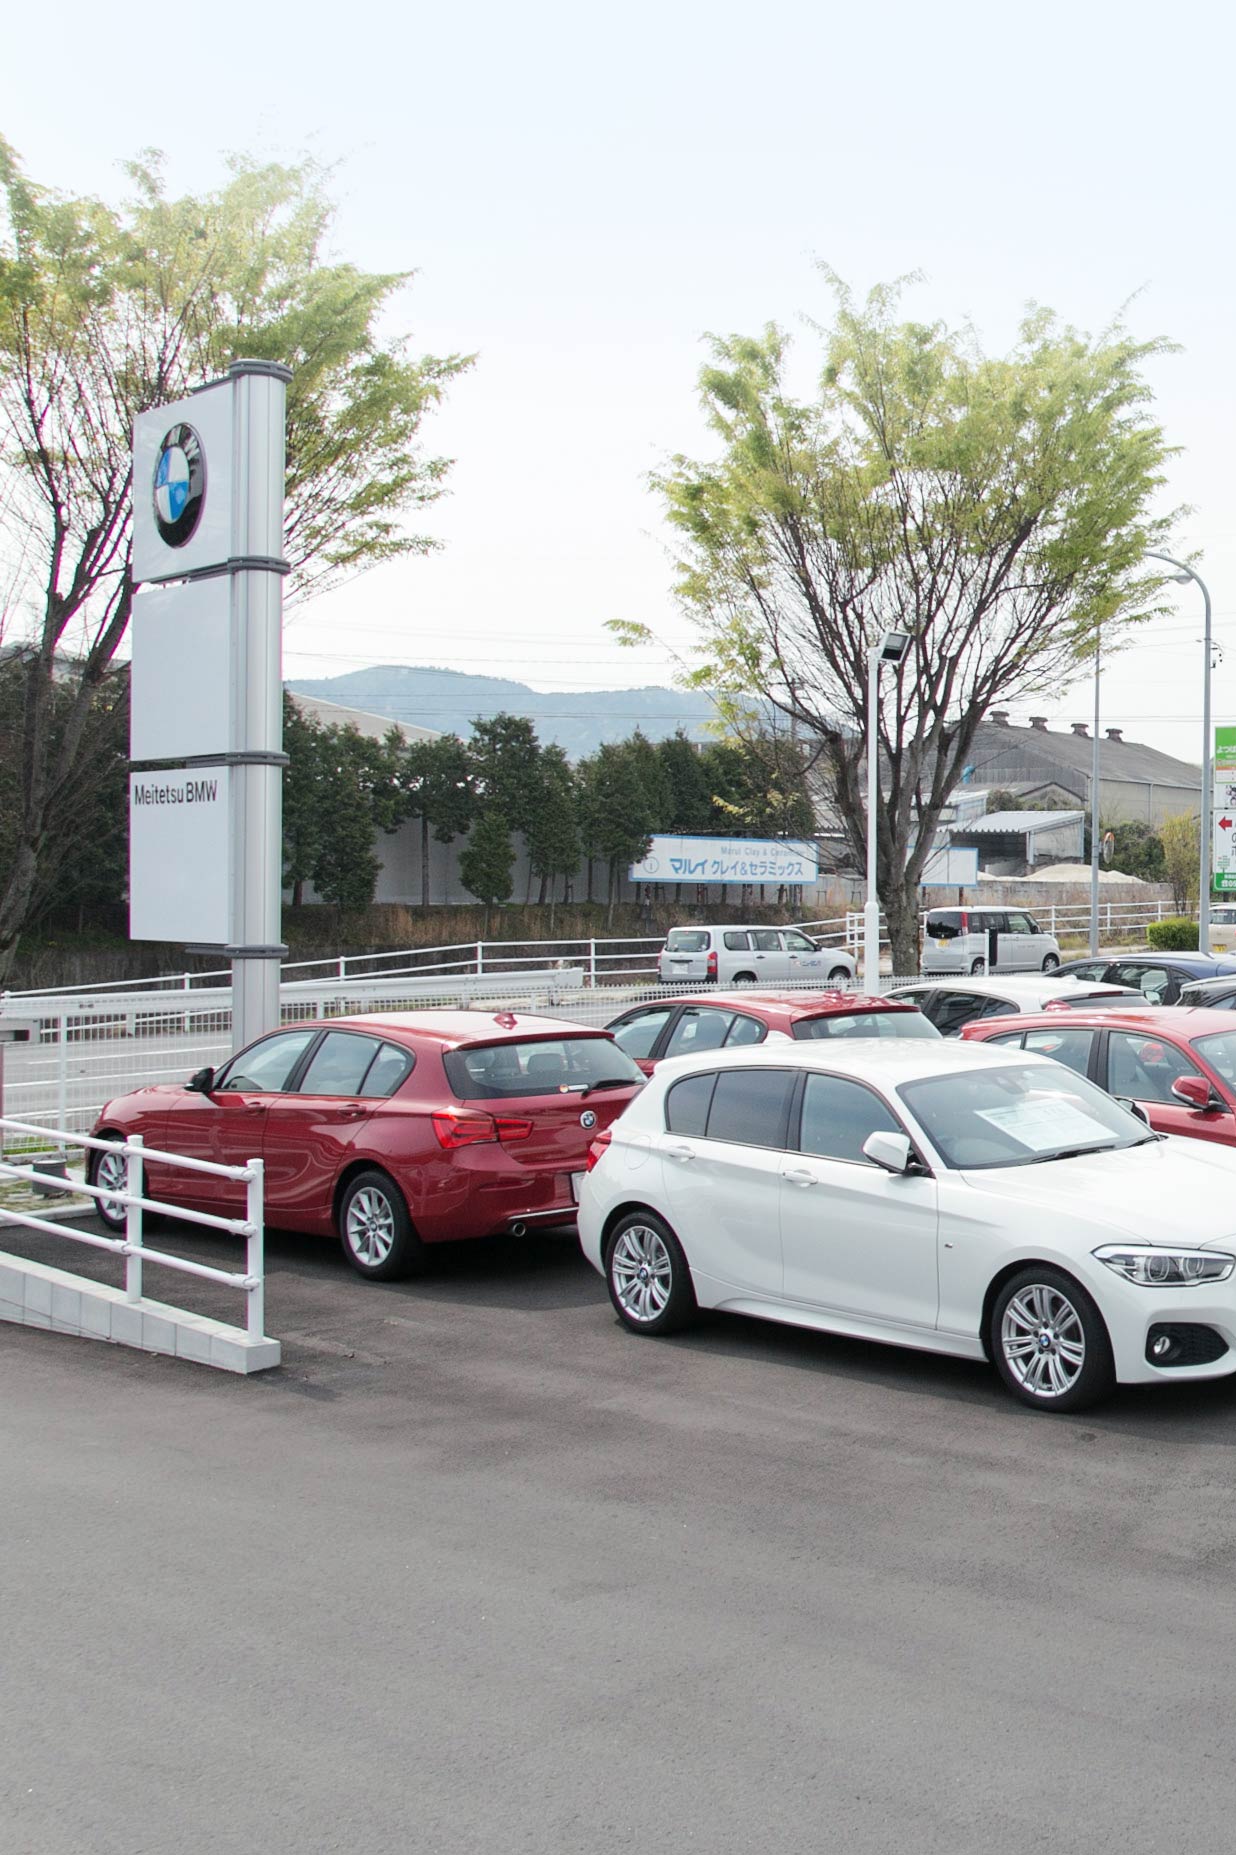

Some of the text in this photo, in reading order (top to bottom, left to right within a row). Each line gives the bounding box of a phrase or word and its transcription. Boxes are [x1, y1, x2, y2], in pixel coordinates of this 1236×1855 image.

[135, 780, 217, 805] Meitetsu BMW
[669, 858, 803, 877] マルイ クレイ&セラミックス
